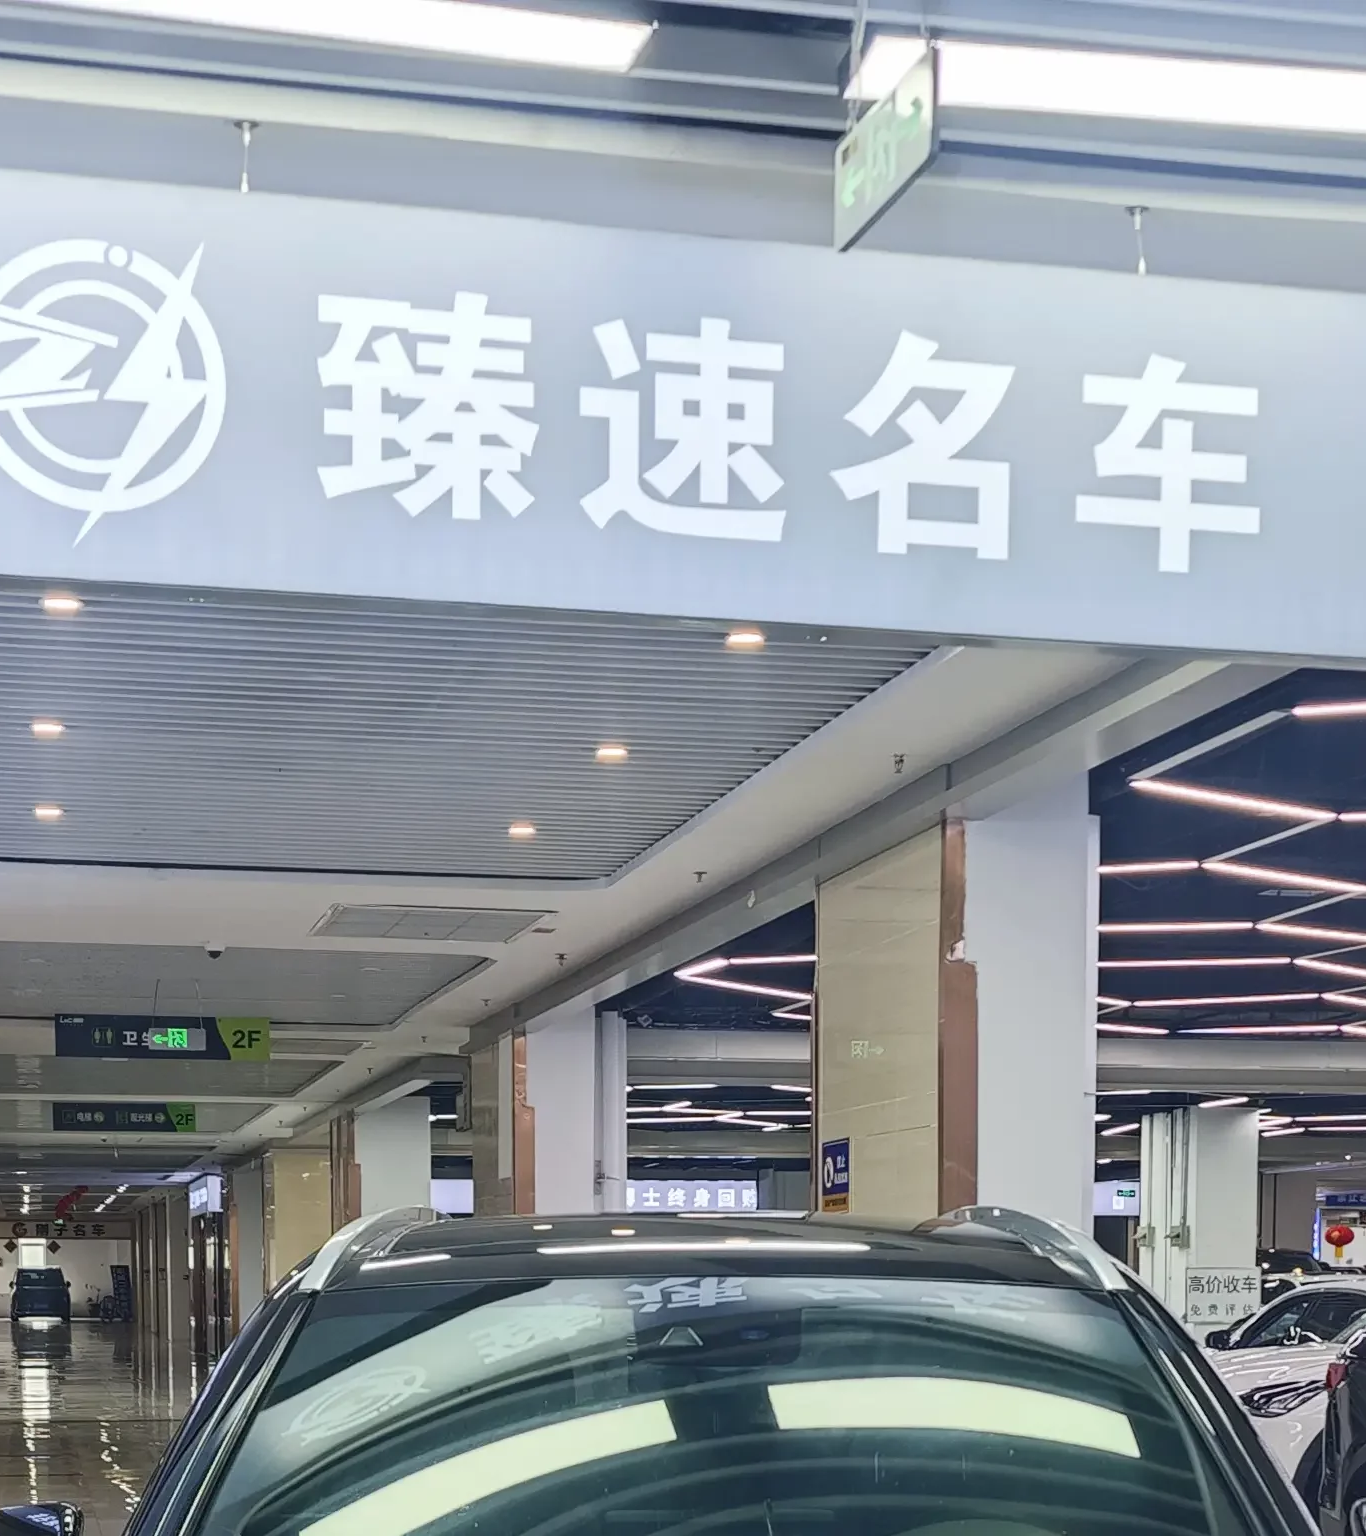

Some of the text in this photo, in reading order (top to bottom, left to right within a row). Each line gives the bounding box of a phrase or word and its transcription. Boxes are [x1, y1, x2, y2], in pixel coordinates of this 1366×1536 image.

[315, 288, 1269, 576] 臻速名车
[231, 1029, 262, 1050] 2F
[175, 1113, 195, 1126] 2F
[1188, 1275, 1258, 1294] 高价收车
